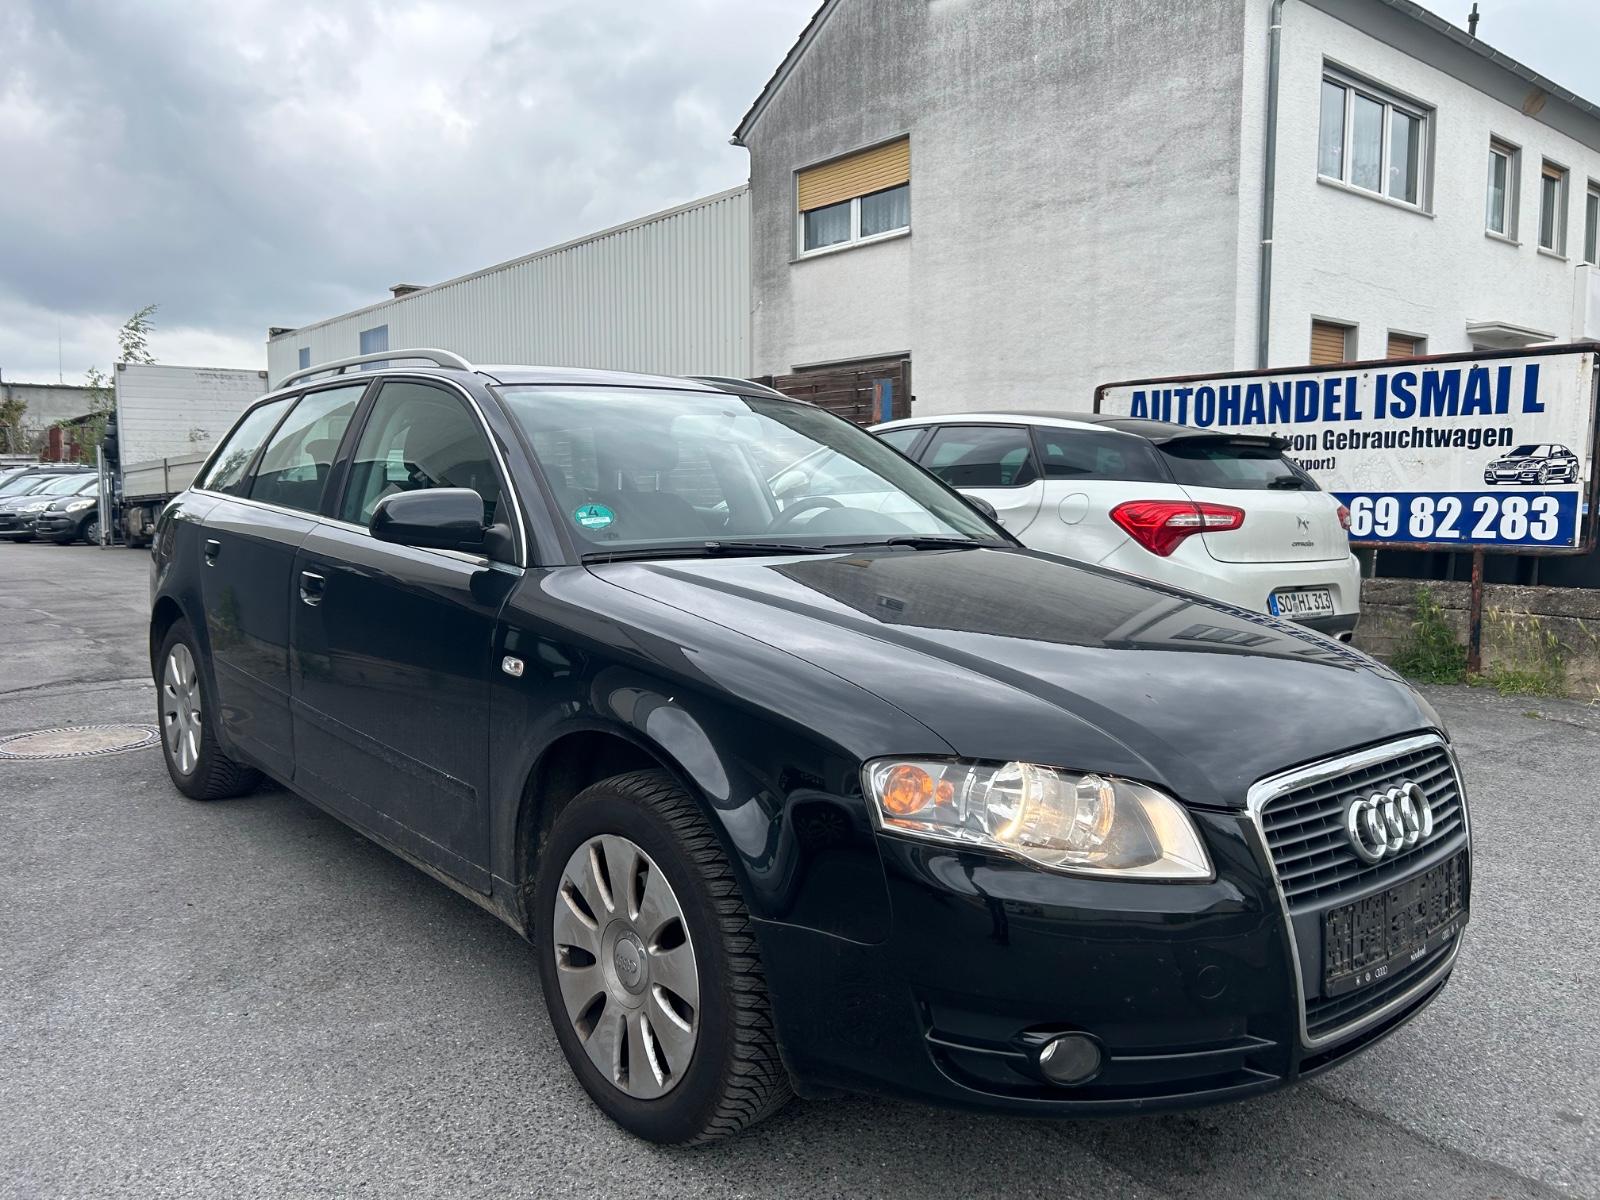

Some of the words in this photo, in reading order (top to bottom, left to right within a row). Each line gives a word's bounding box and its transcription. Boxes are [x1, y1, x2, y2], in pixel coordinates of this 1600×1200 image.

[1130, 376, 1363, 428] AUTOHANDEL
[1322, 427, 1513, 451] Gebrauchtwagen
[1349, 496, 1399, 537] 69
[1408, 496, 1462, 538] 82
[1471, 495, 1560, 541] 283
[1278, 595, 1293, 613] SO
[1312, 592, 1331, 609] 313
